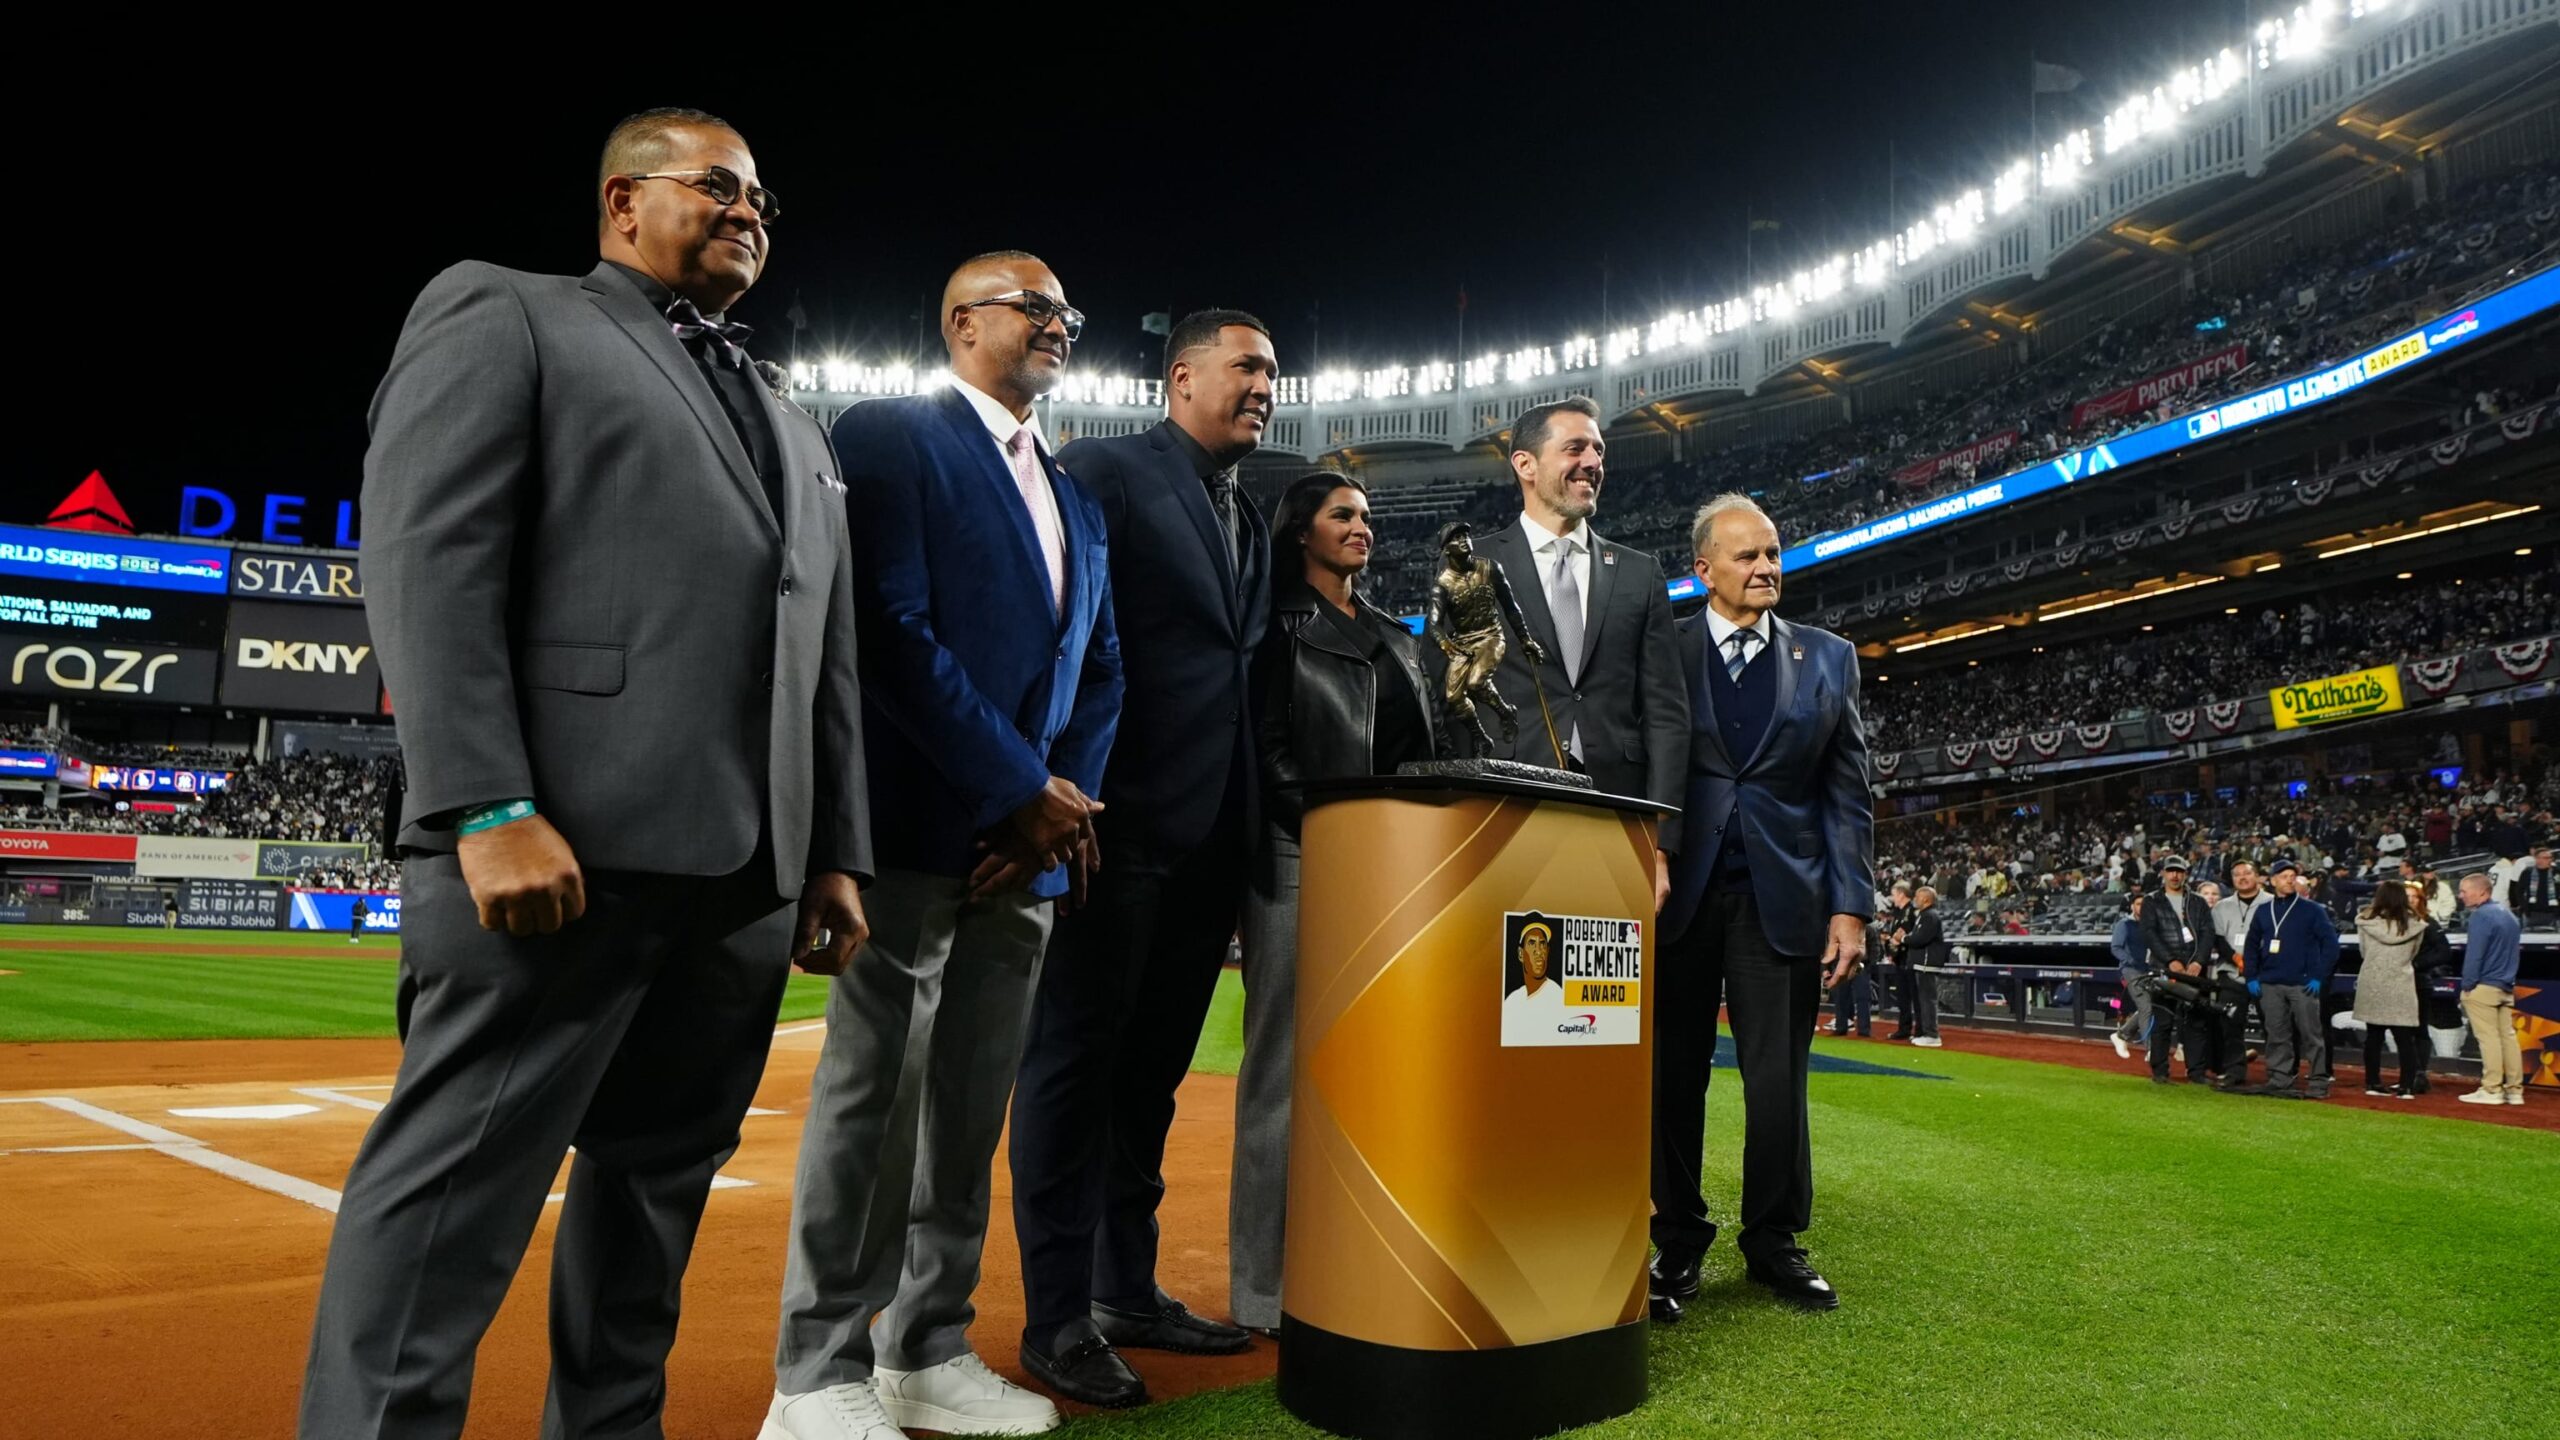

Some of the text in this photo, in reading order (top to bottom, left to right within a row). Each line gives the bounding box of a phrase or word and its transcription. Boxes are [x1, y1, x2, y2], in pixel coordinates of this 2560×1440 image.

[2138, 352, 2239, 405] PARTY DECK
[2288, 359, 2366, 407] CLEMENTE
[2370, 339, 2420, 372] AWARD
[1815, 483, 2004, 558] CONGRATULATIONS SALVADOR PEREZ
[45, 548, 118, 570] SERIES
[238, 558, 364, 598] STAR
[23, 610, 49, 624] ALL
[51, 613, 69, 625] OF
[71, 615, 98, 628] THE
[49, 600, 121, 619] SALVADOR,
[123, 606, 151, 620] AND
[238, 638, 370, 675] DKNY
[12, 644, 179, 694] razr
[2281, 675, 2383, 714] Nathan's
[0, 837, 49, 850] OYOTA
[141, 852, 168, 860] BANK
[185, 853, 230, 862] AMERICA
[63, 908, 83, 920] 385
[127, 912, 168, 924] StubHu
[181, 913, 276, 927] StubHub StubHub
[365, 912, 400, 928] SAL
[1565, 918, 1617, 943] ROBERTO
[1564, 944, 1640, 978] CLEMENTE
[1581, 984, 1626, 1003] AWARD
